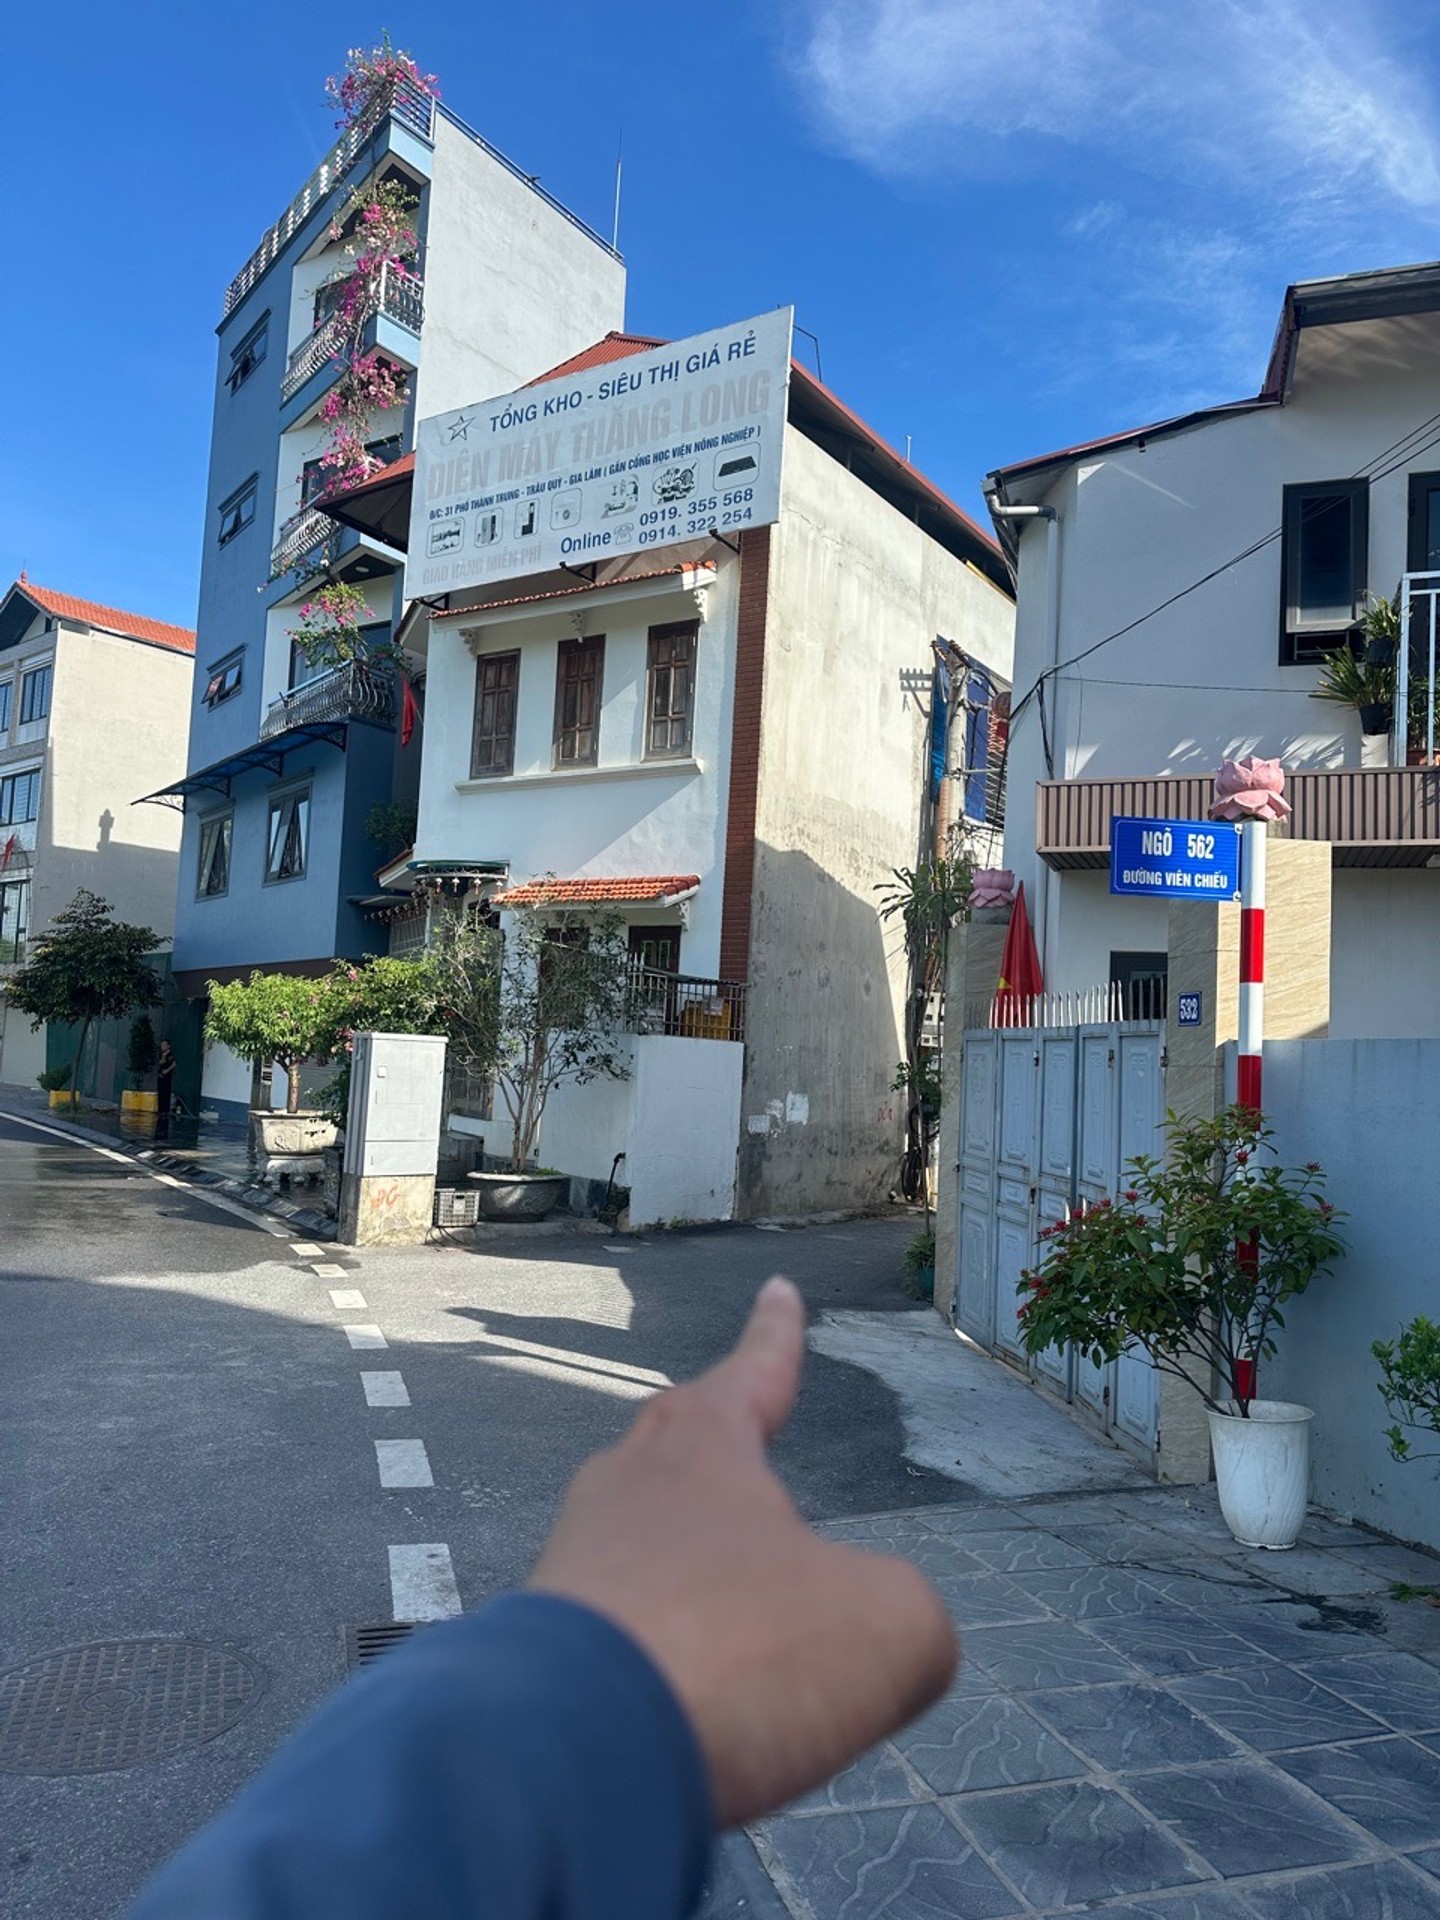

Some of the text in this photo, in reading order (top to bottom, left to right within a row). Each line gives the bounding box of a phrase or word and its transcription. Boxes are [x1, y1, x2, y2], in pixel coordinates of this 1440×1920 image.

[490, 402, 537, 432] TỔNG
[543, 391, 582, 416] KHO
[599, 372, 642, 400] SIÊU
[648, 360, 680, 385] THỊ
[686, 343, 720, 373] GIÁ
[728, 330, 756, 361] RẺ
[499, 429, 561, 483] MÁY
[680, 369, 771, 433] LONG
[495, 488, 520, 503] TRUNG
[569, 475, 583, 487] GIA
[652, 450, 670, 464] HỌC
[721, 426, 755, 446] NGHIỆP
[639, 488, 754, 526] 0919. 355 568
[639, 507, 753, 544] 0914. 322 254
[561, 530, 612, 554] Online
[1142, 827, 1215, 859] NGÕ 562
[1123, 867, 1162, 885] ĐƯỜNG
[1165, 869, 1191, 887] VIÊN
